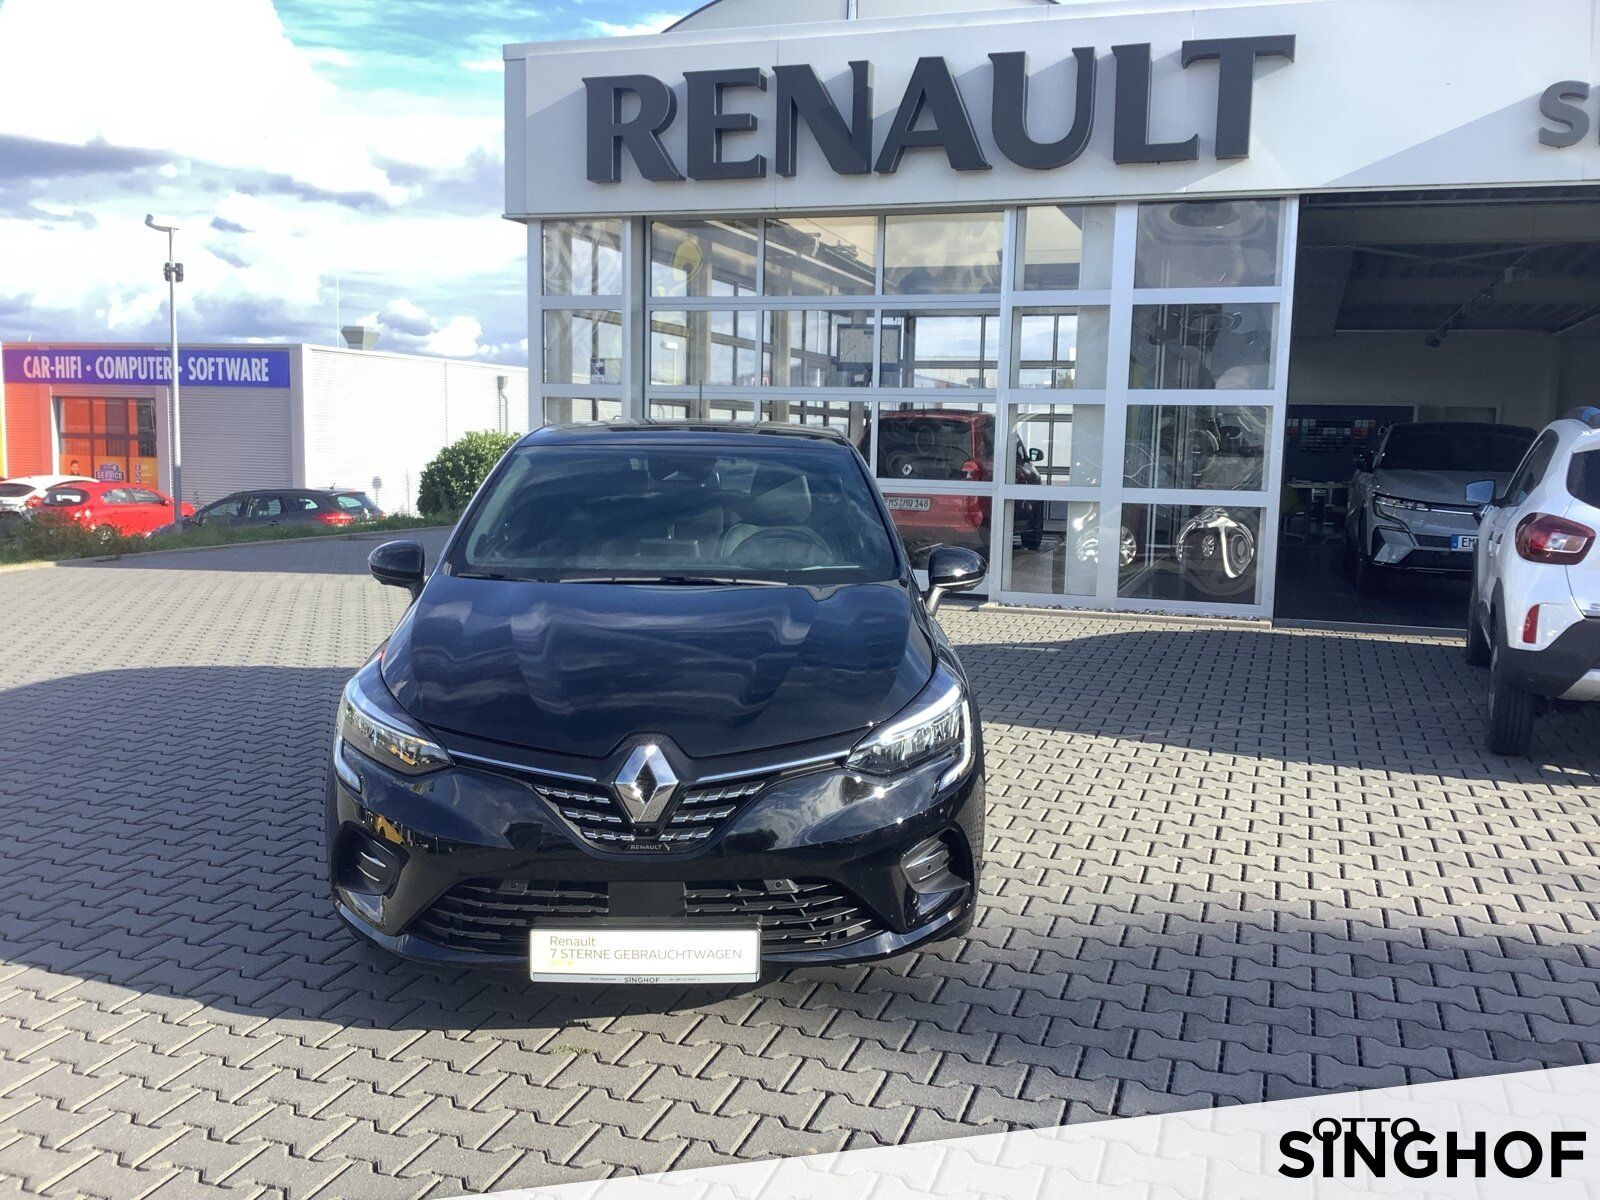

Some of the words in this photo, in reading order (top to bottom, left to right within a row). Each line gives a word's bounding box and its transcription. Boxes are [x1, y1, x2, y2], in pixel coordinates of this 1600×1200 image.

[582, 34, 1296, 183] RENAULT
[1539, 80, 1600, 148] S
[23, 355, 82, 379] CAR-HIFI
[95, 356, 172, 380] COMPUTER
[187, 356, 270, 382] SOFTWARE
[97, 472, 123, 480] SERVICE
[549, 935, 597, 947] Renault
[550, 948, 558, 959] 7
[560, 948, 611, 960] STERNE
[613, 949, 743, 960] GEBRAUCHTWAGEN
[624, 976, 661, 984] SINGHOF
